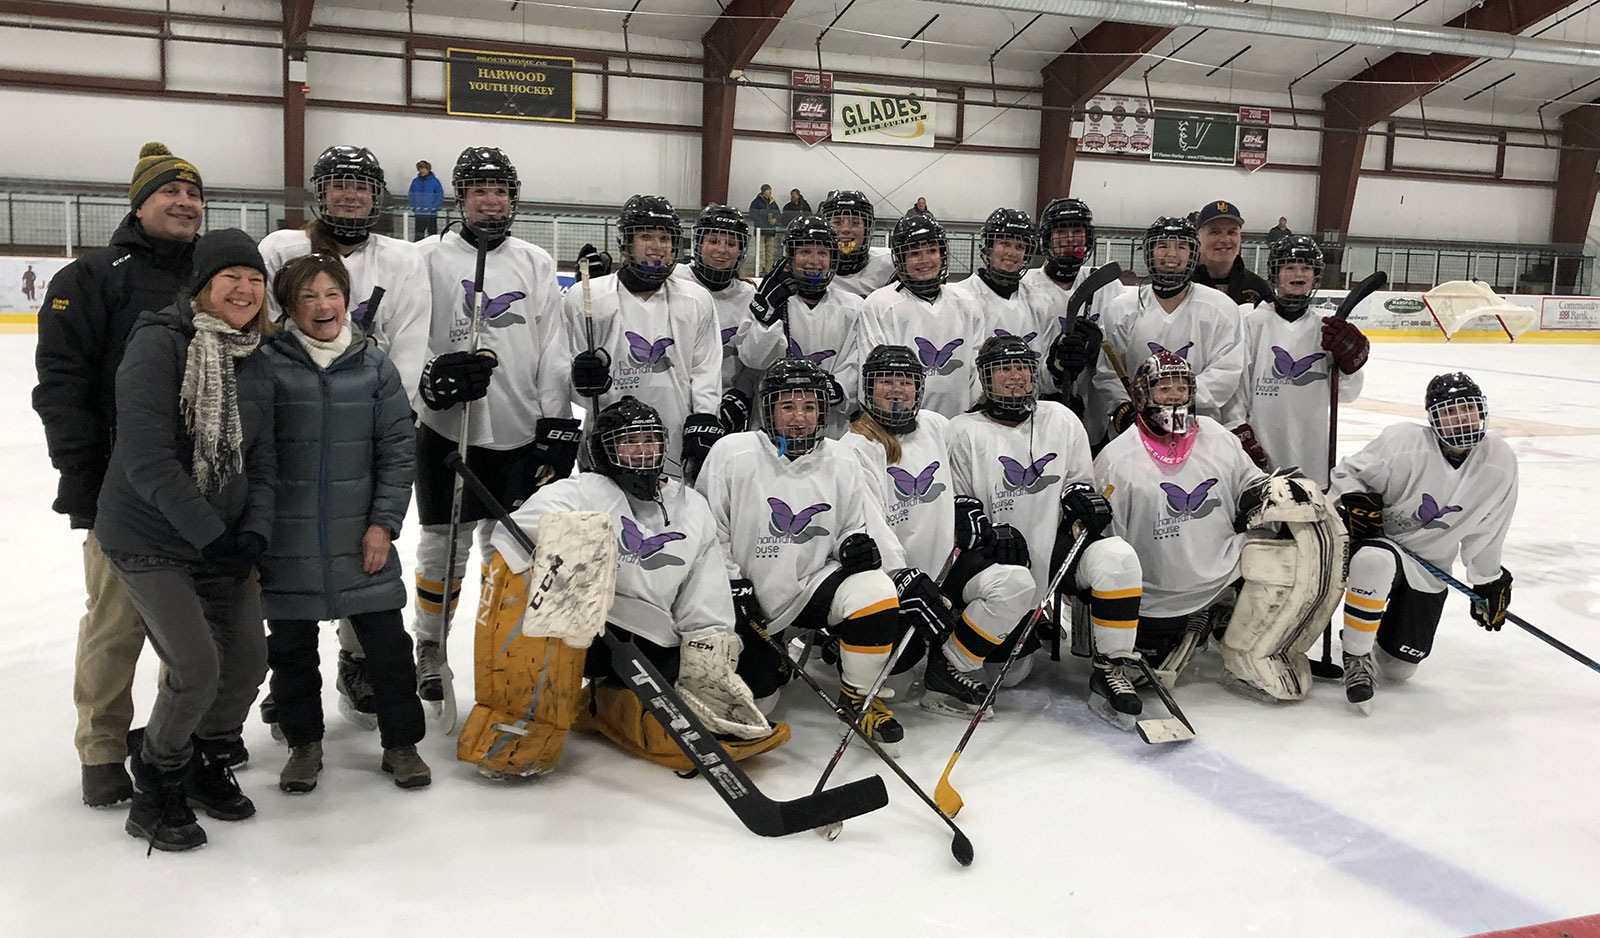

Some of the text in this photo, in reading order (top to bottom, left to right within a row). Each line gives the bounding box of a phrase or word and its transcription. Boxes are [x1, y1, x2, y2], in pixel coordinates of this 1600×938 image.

[478, 68, 546, 82] HARWOOD
[804, 74, 820, 84] 2018
[468, 81, 555, 96] YOUTH HOCKEY
[842, 93, 921, 127] GLADES
[716, 216, 738, 224] CCM
[112, 253, 131, 267] CCM
[612, 370, 640, 386] house
[1256, 378, 1280, 392] house
[1172, 413, 1185, 431] N
[1351, 507, 1382, 518] CC
[1153, 521, 1180, 537] house
[755, 544, 779, 554] ouse
[530, 554, 564, 611] CCM
[1351, 587, 1373, 597] CCM
[688, 641, 714, 651] CCM
[1400, 645, 1427, 658] CCM
[631, 659, 749, 800] TRUE
